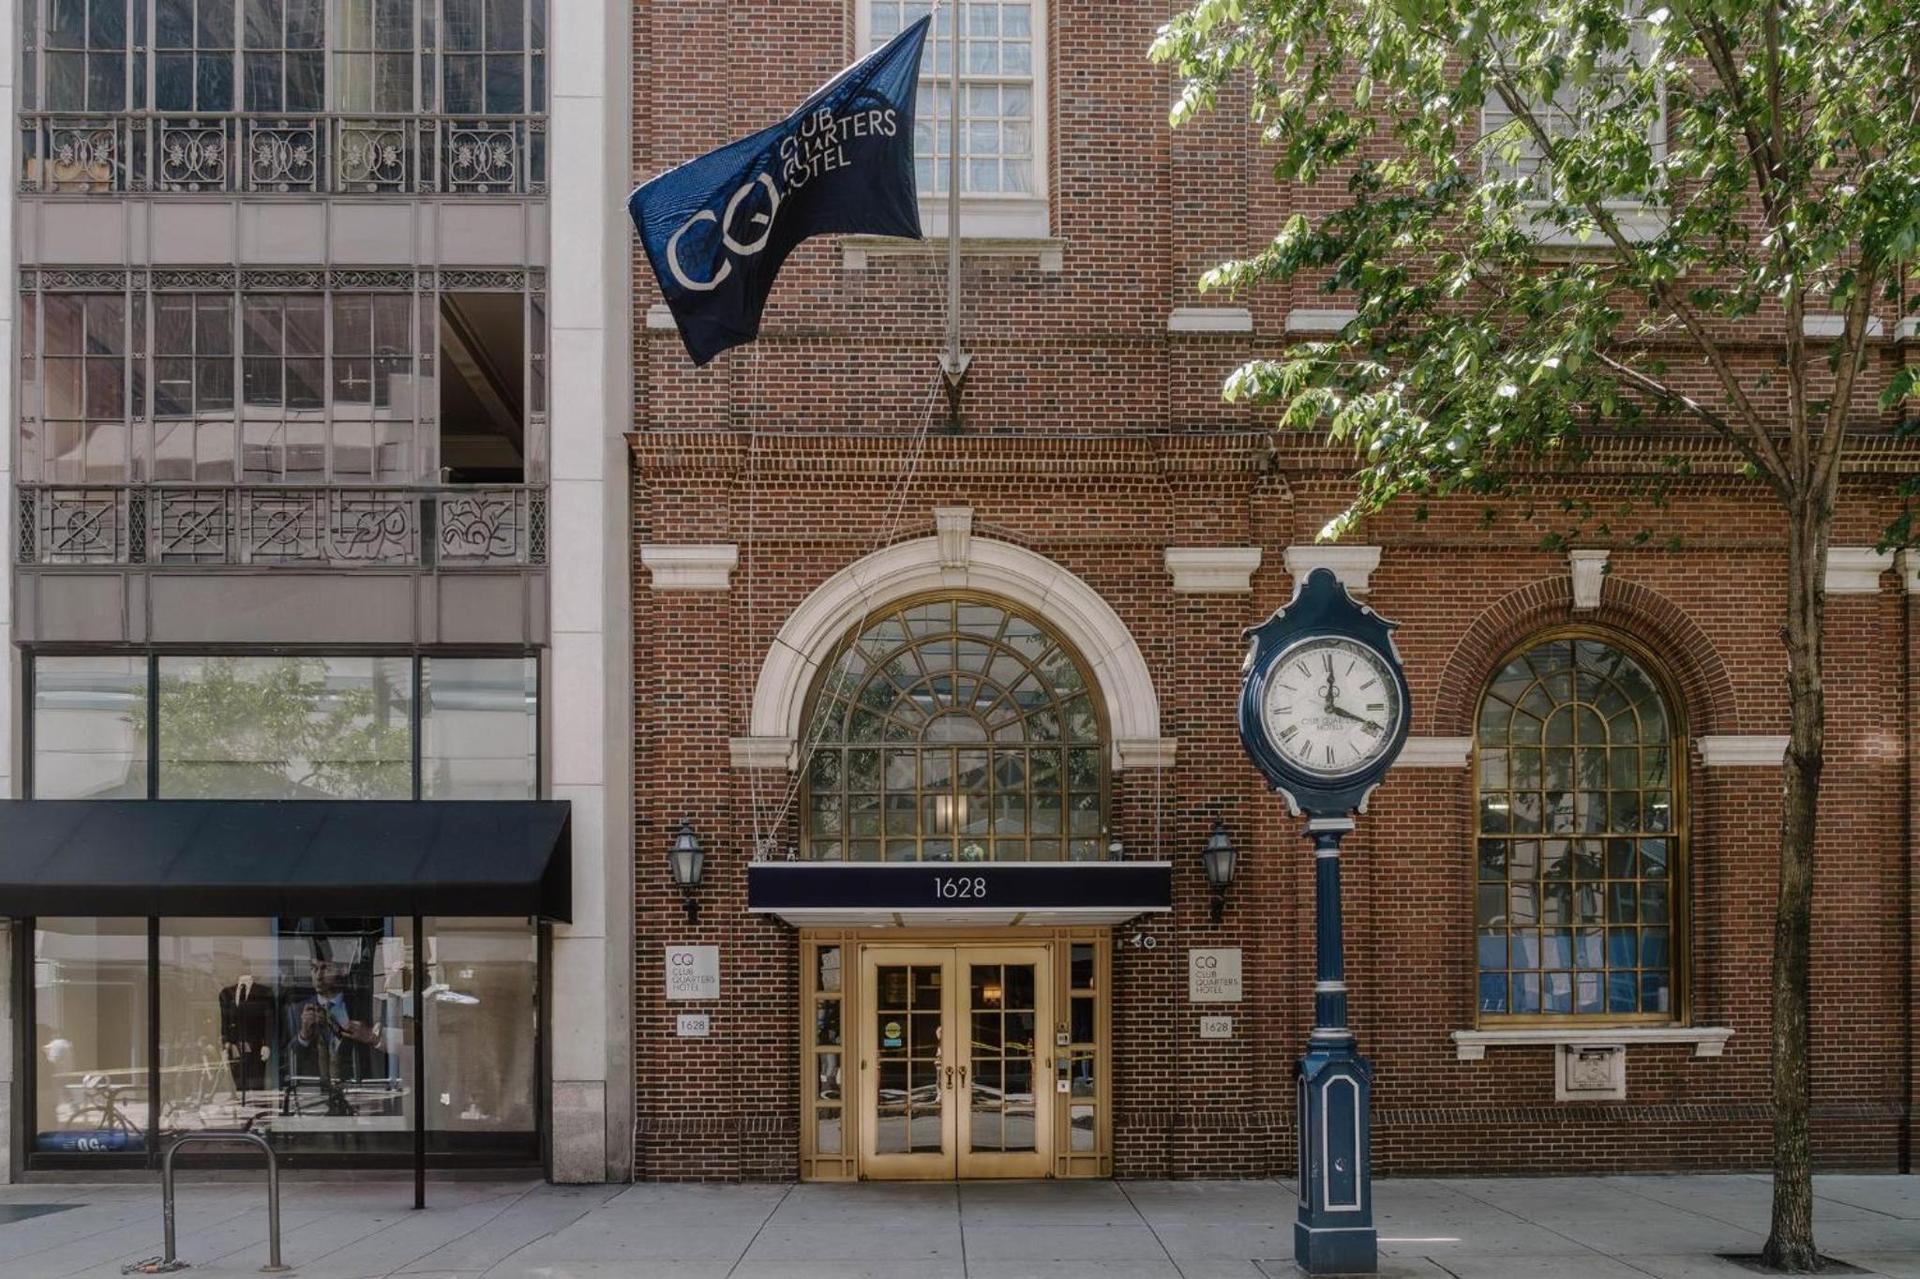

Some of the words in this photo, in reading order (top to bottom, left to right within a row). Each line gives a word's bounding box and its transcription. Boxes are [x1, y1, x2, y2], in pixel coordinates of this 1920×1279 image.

[667, 172, 781, 291] CQ
[934, 877, 986, 898] 1628
[672, 952, 694, 966] CQ
[1195, 955, 1217, 969] CQ
[672, 968, 694, 976] CLUB
[681, 1021, 705, 1030] 1628
[1205, 1022, 1229, 1032] 1628
